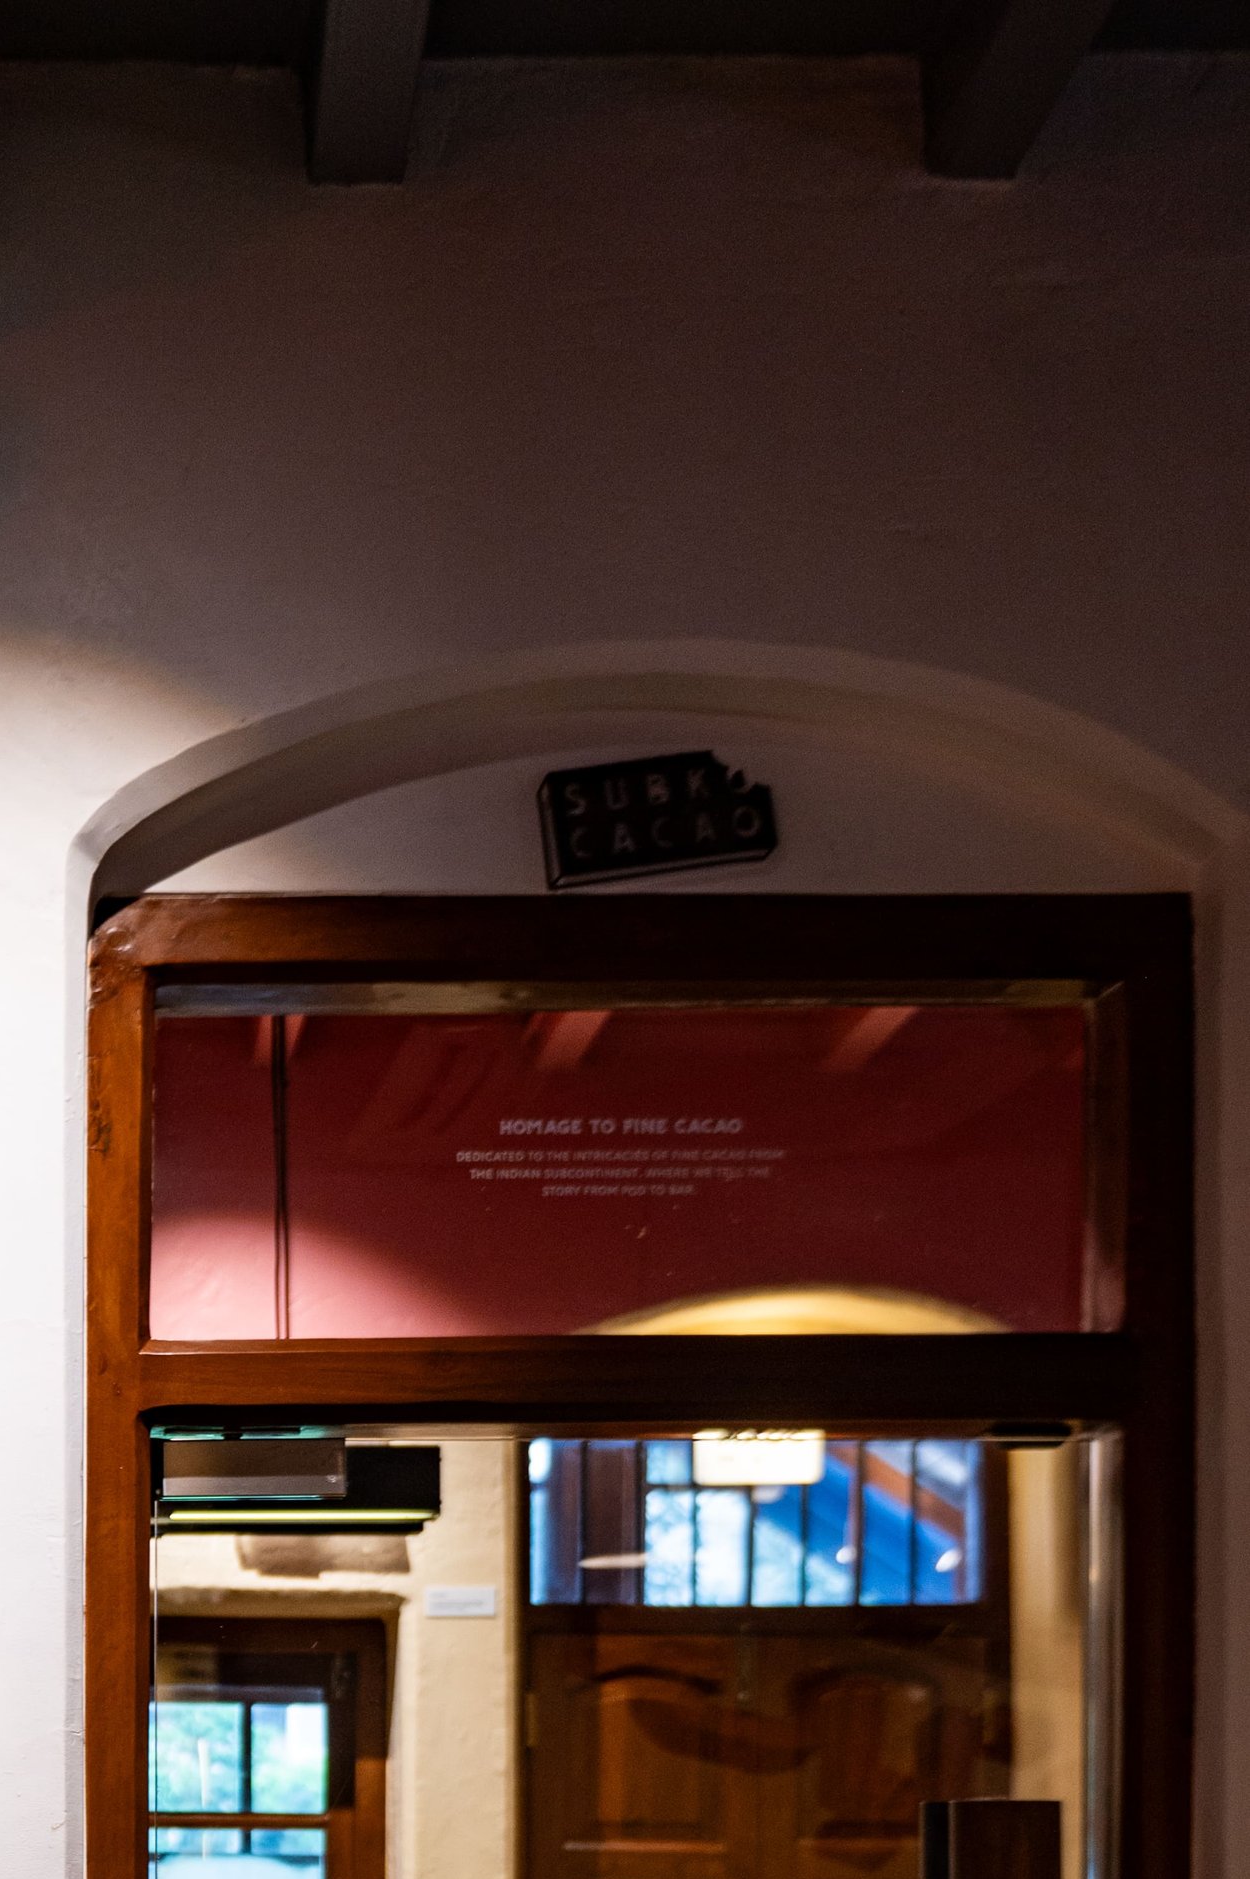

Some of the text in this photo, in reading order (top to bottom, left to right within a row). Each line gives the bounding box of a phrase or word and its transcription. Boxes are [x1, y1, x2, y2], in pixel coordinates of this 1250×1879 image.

[569, 804, 761, 859] CACAO
[499, 1118, 743, 1135] HOMAGE TO FINE CACAO
